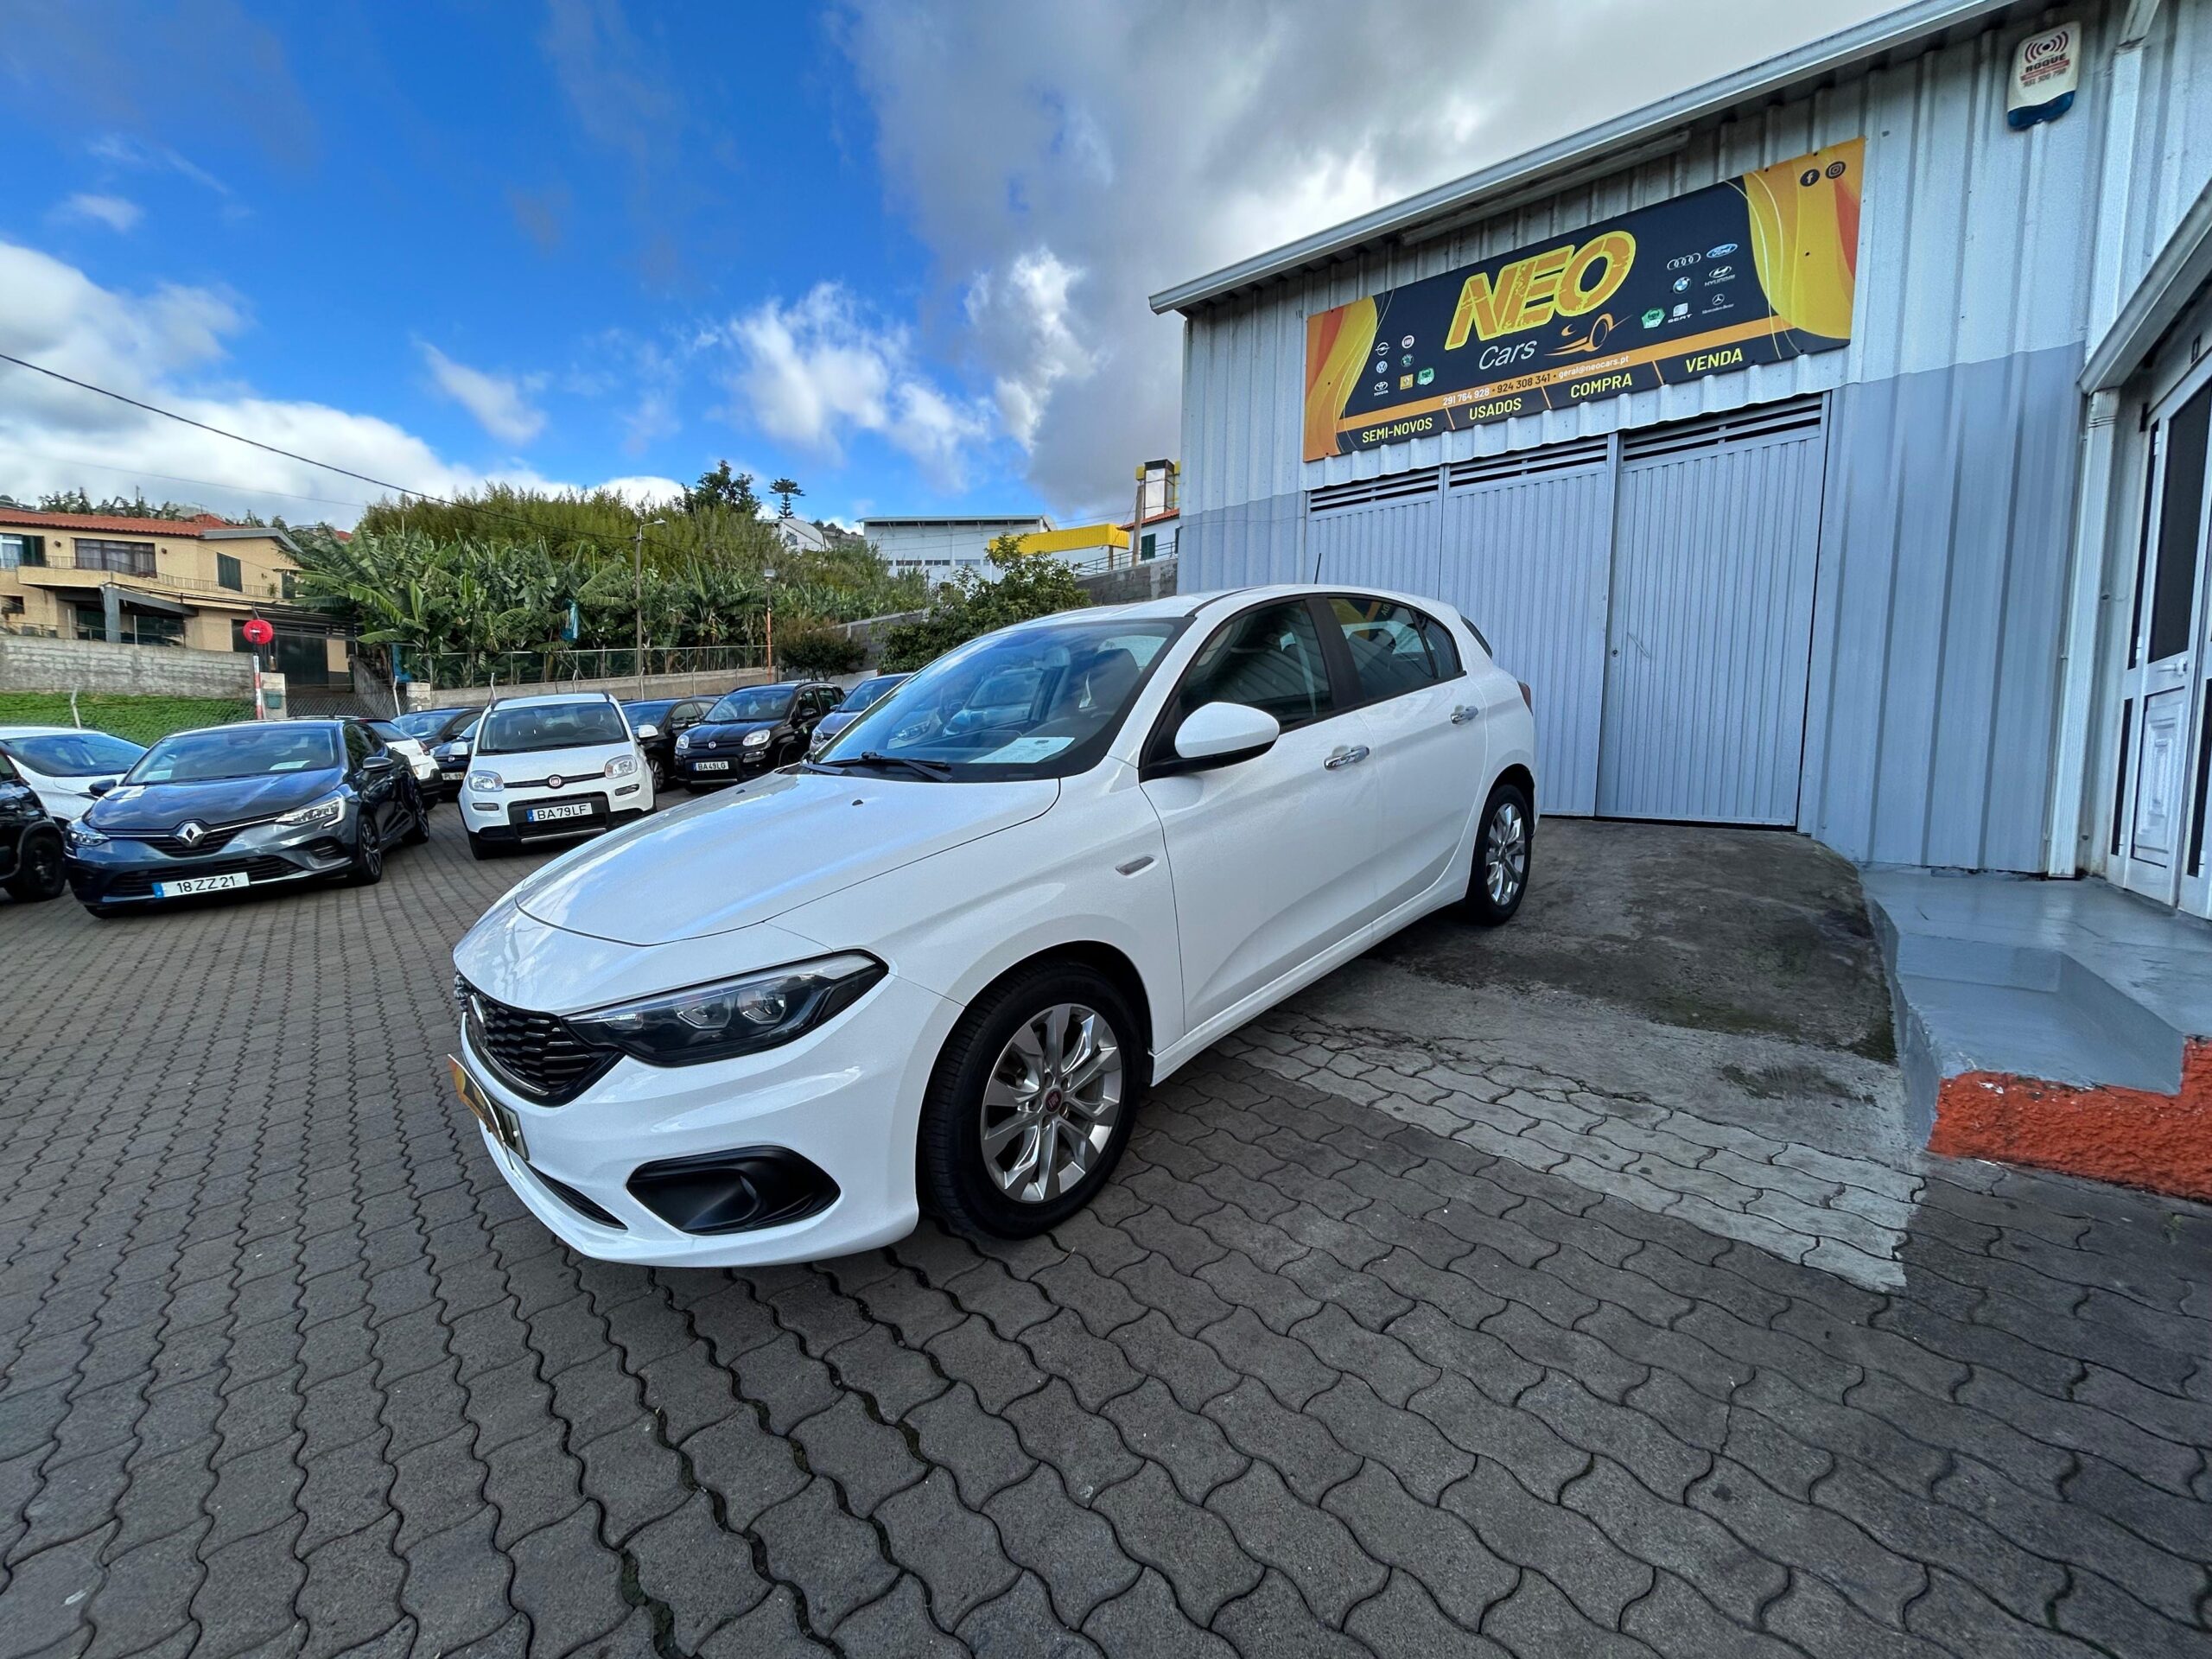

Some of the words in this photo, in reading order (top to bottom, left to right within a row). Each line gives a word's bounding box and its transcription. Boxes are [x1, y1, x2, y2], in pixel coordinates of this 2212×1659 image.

[2024, 53, 2067, 73] ROQUE
[1445, 231, 1637, 351] NEO
[1478, 340, 1537, 371] Cars
[1685, 347, 1744, 373] VENDA
[1443, 397, 1456, 406] 291
[1458, 392, 1472, 402] 764
[1474, 388, 1490, 398] 928
[1497, 384, 1514, 394] 924
[1516, 378, 1533, 389] 308
[1535, 373, 1551, 385] 341
[1558, 355, 1630, 379] geral@neocars.pt
[1570, 372, 1633, 398] COMPRA
[1469, 397, 1522, 421] USADOS
[1362, 417, 1433, 443] SEMI-NOVOS
